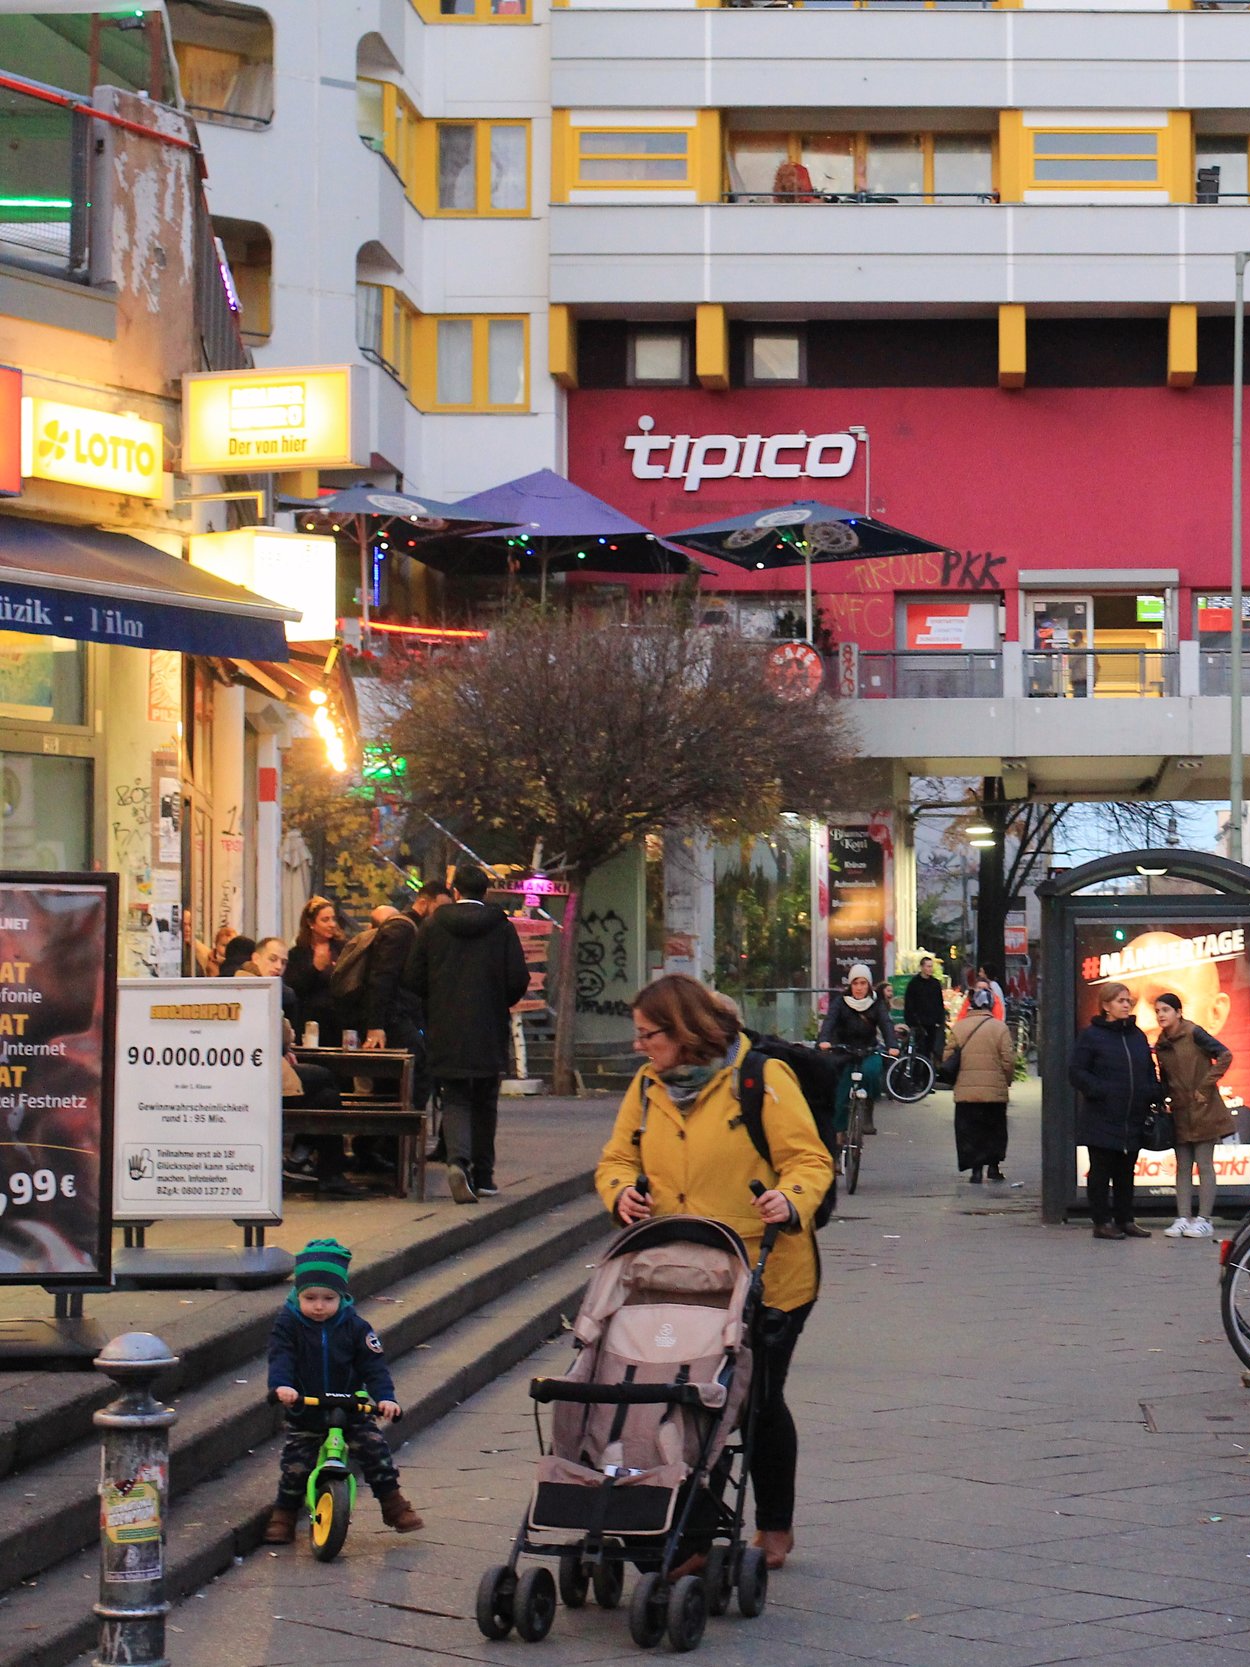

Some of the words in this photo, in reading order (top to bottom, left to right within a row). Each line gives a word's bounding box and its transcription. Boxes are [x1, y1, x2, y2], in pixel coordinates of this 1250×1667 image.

[76, 428, 155, 476] LOTTO
[229, 438, 251, 455] Der
[256, 440, 278, 454] von
[281, 435, 307, 453] hier
[624, 415, 857, 491] tipico
[940, 551, 1006, 589] PKK
[0, 987, 42, 1003] fonie
[150, 1002, 241, 1022] EUROJACKPOT
[3, 1040, 67, 1056] Internet
[128, 1046, 245, 1067] 90.000.000
[251, 1048, 263, 1067] €
[0, 1094, 15, 1109] ei
[19, 1093, 87, 1109] Festnetz
[138, 1102, 249, 1112] Gewinnwahrscheinlichkeit
